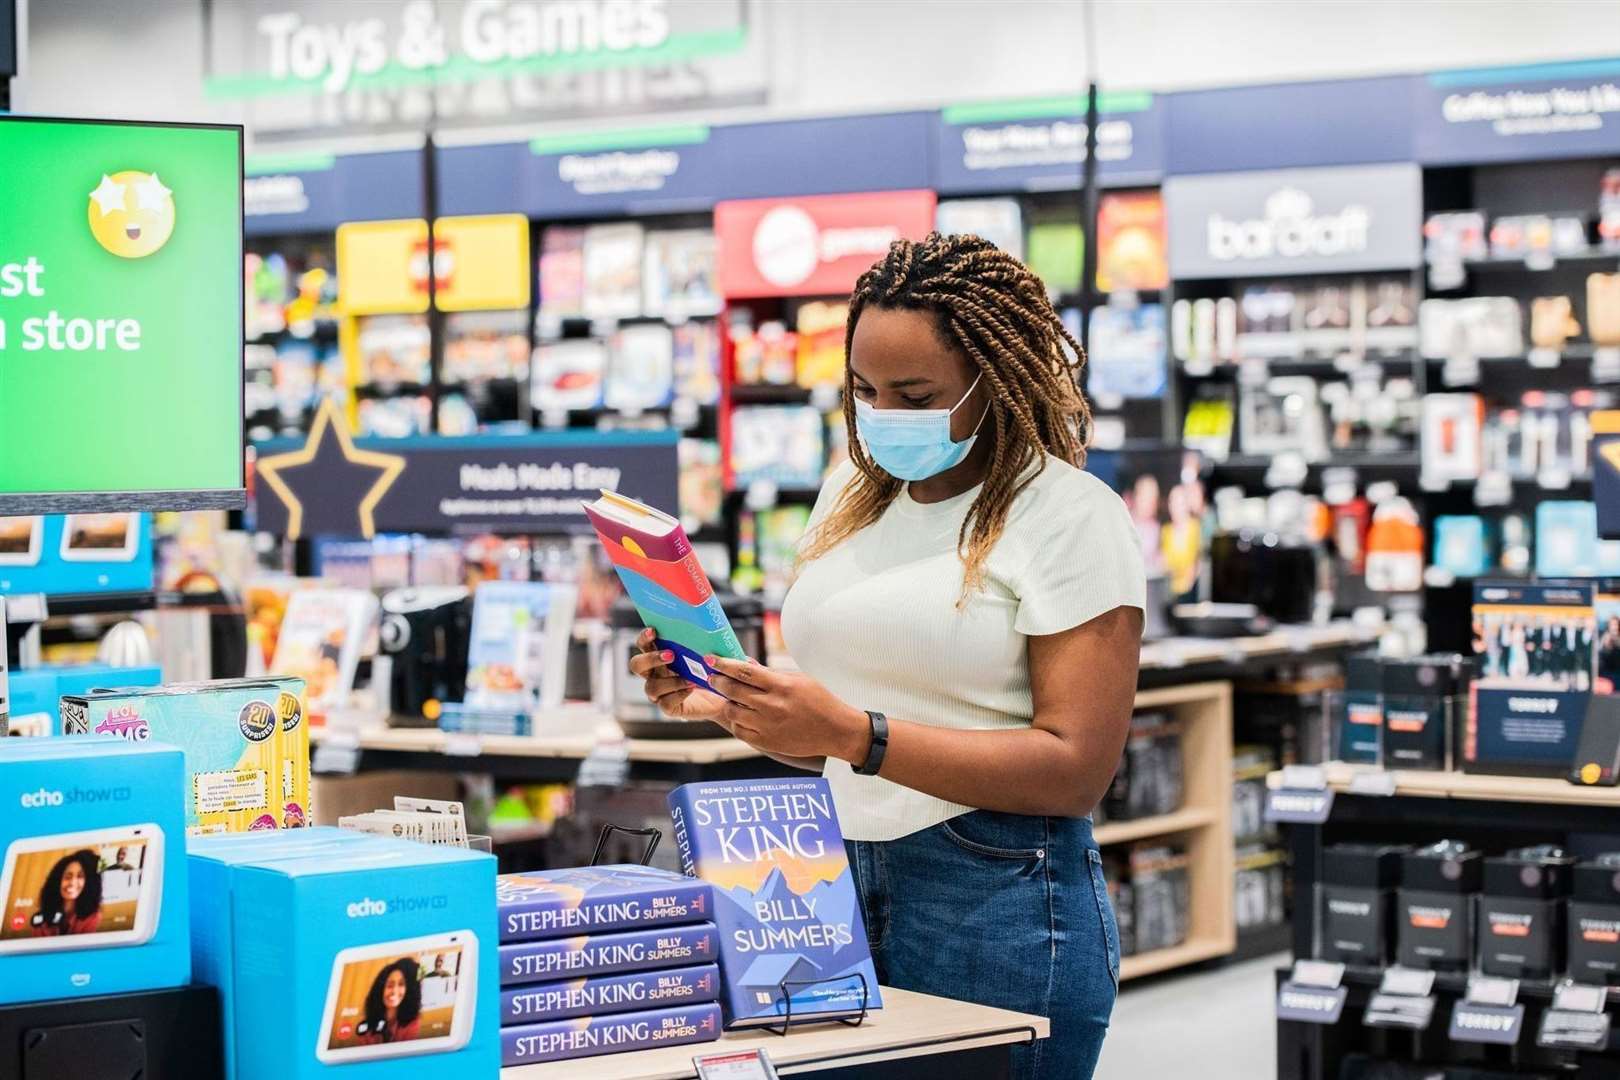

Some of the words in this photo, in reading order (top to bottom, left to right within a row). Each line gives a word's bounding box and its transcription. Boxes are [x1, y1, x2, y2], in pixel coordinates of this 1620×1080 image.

[259, 13, 387, 92] Toys
[396, 0, 449, 69] &
[462, 0, 670, 62] Games
[22, 310, 141, 351] store
[460, 463, 517, 491] Meals
[518, 462, 572, 491] Made
[573, 462, 621, 493] Easy
[251, 705, 269, 725] 20
[241, 719, 274, 739] SURPRISES!
[20, 787, 64, 808] echo
[65, 787, 111, 804] show
[749, 784, 790, 792] BESTSELLING
[694, 794, 831, 826] STEPHEN
[671, 806, 696, 880] STEPHE
[715, 823, 825, 863] KING
[347, 897, 387, 918] echo
[387, 896, 429, 913] show
[653, 896, 677, 908] BILLY
[755, 897, 817, 922] BILLY
[508, 907, 590, 933] STEPHEN
[594, 901, 640, 924] KING
[643, 907, 687, 920] SUMMERS
[657, 937, 681, 949] BILLY
[734, 924, 853, 952] SUMMERS
[512, 948, 594, 976] STEPHEN
[599, 943, 645, 966] KING
[648, 948, 692, 961] SUMMERS
[649, 986, 693, 1000] SUMMERS
[658, 976, 683, 988] BILLY
[512, 989, 595, 1015] STEPHEN
[599, 982, 645, 1005] KING
[662, 1016, 687, 1028] BILLY
[515, 1029, 598, 1056] STEPHEN
[603, 1022, 649, 1045] KING
[652, 1027, 697, 1041] SUMMERS
